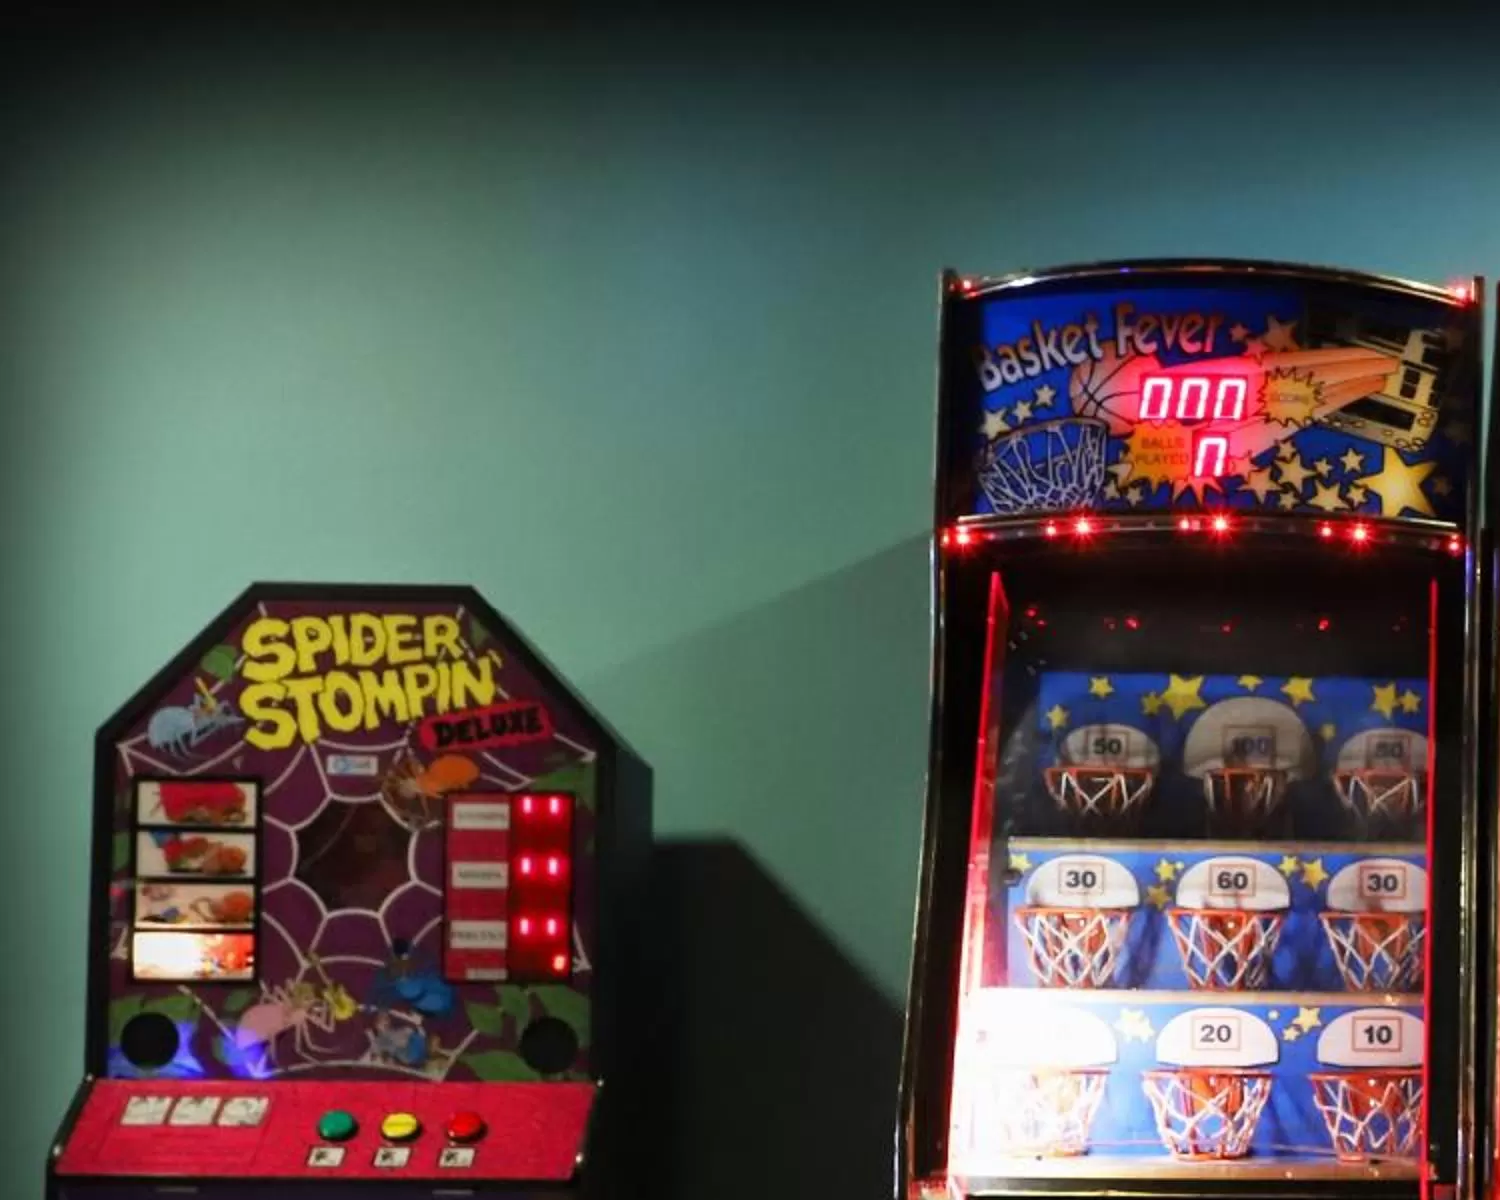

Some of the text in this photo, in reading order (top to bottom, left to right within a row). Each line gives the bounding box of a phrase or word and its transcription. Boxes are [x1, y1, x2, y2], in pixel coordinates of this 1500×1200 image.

[978, 302, 1224, 392] Basket Fever
[241, 612, 465, 684] SPIDER
[431, 706, 543, 747] DELUXE
[1092, 737, 1123, 756] 50
[1064, 870, 1097, 889] 30
[1216, 871, 1249, 890] 60
[1367, 874, 1398, 893] 30
[1200, 1025, 1232, 1044] 20
[1362, 1026, 1393, 1044] 10
